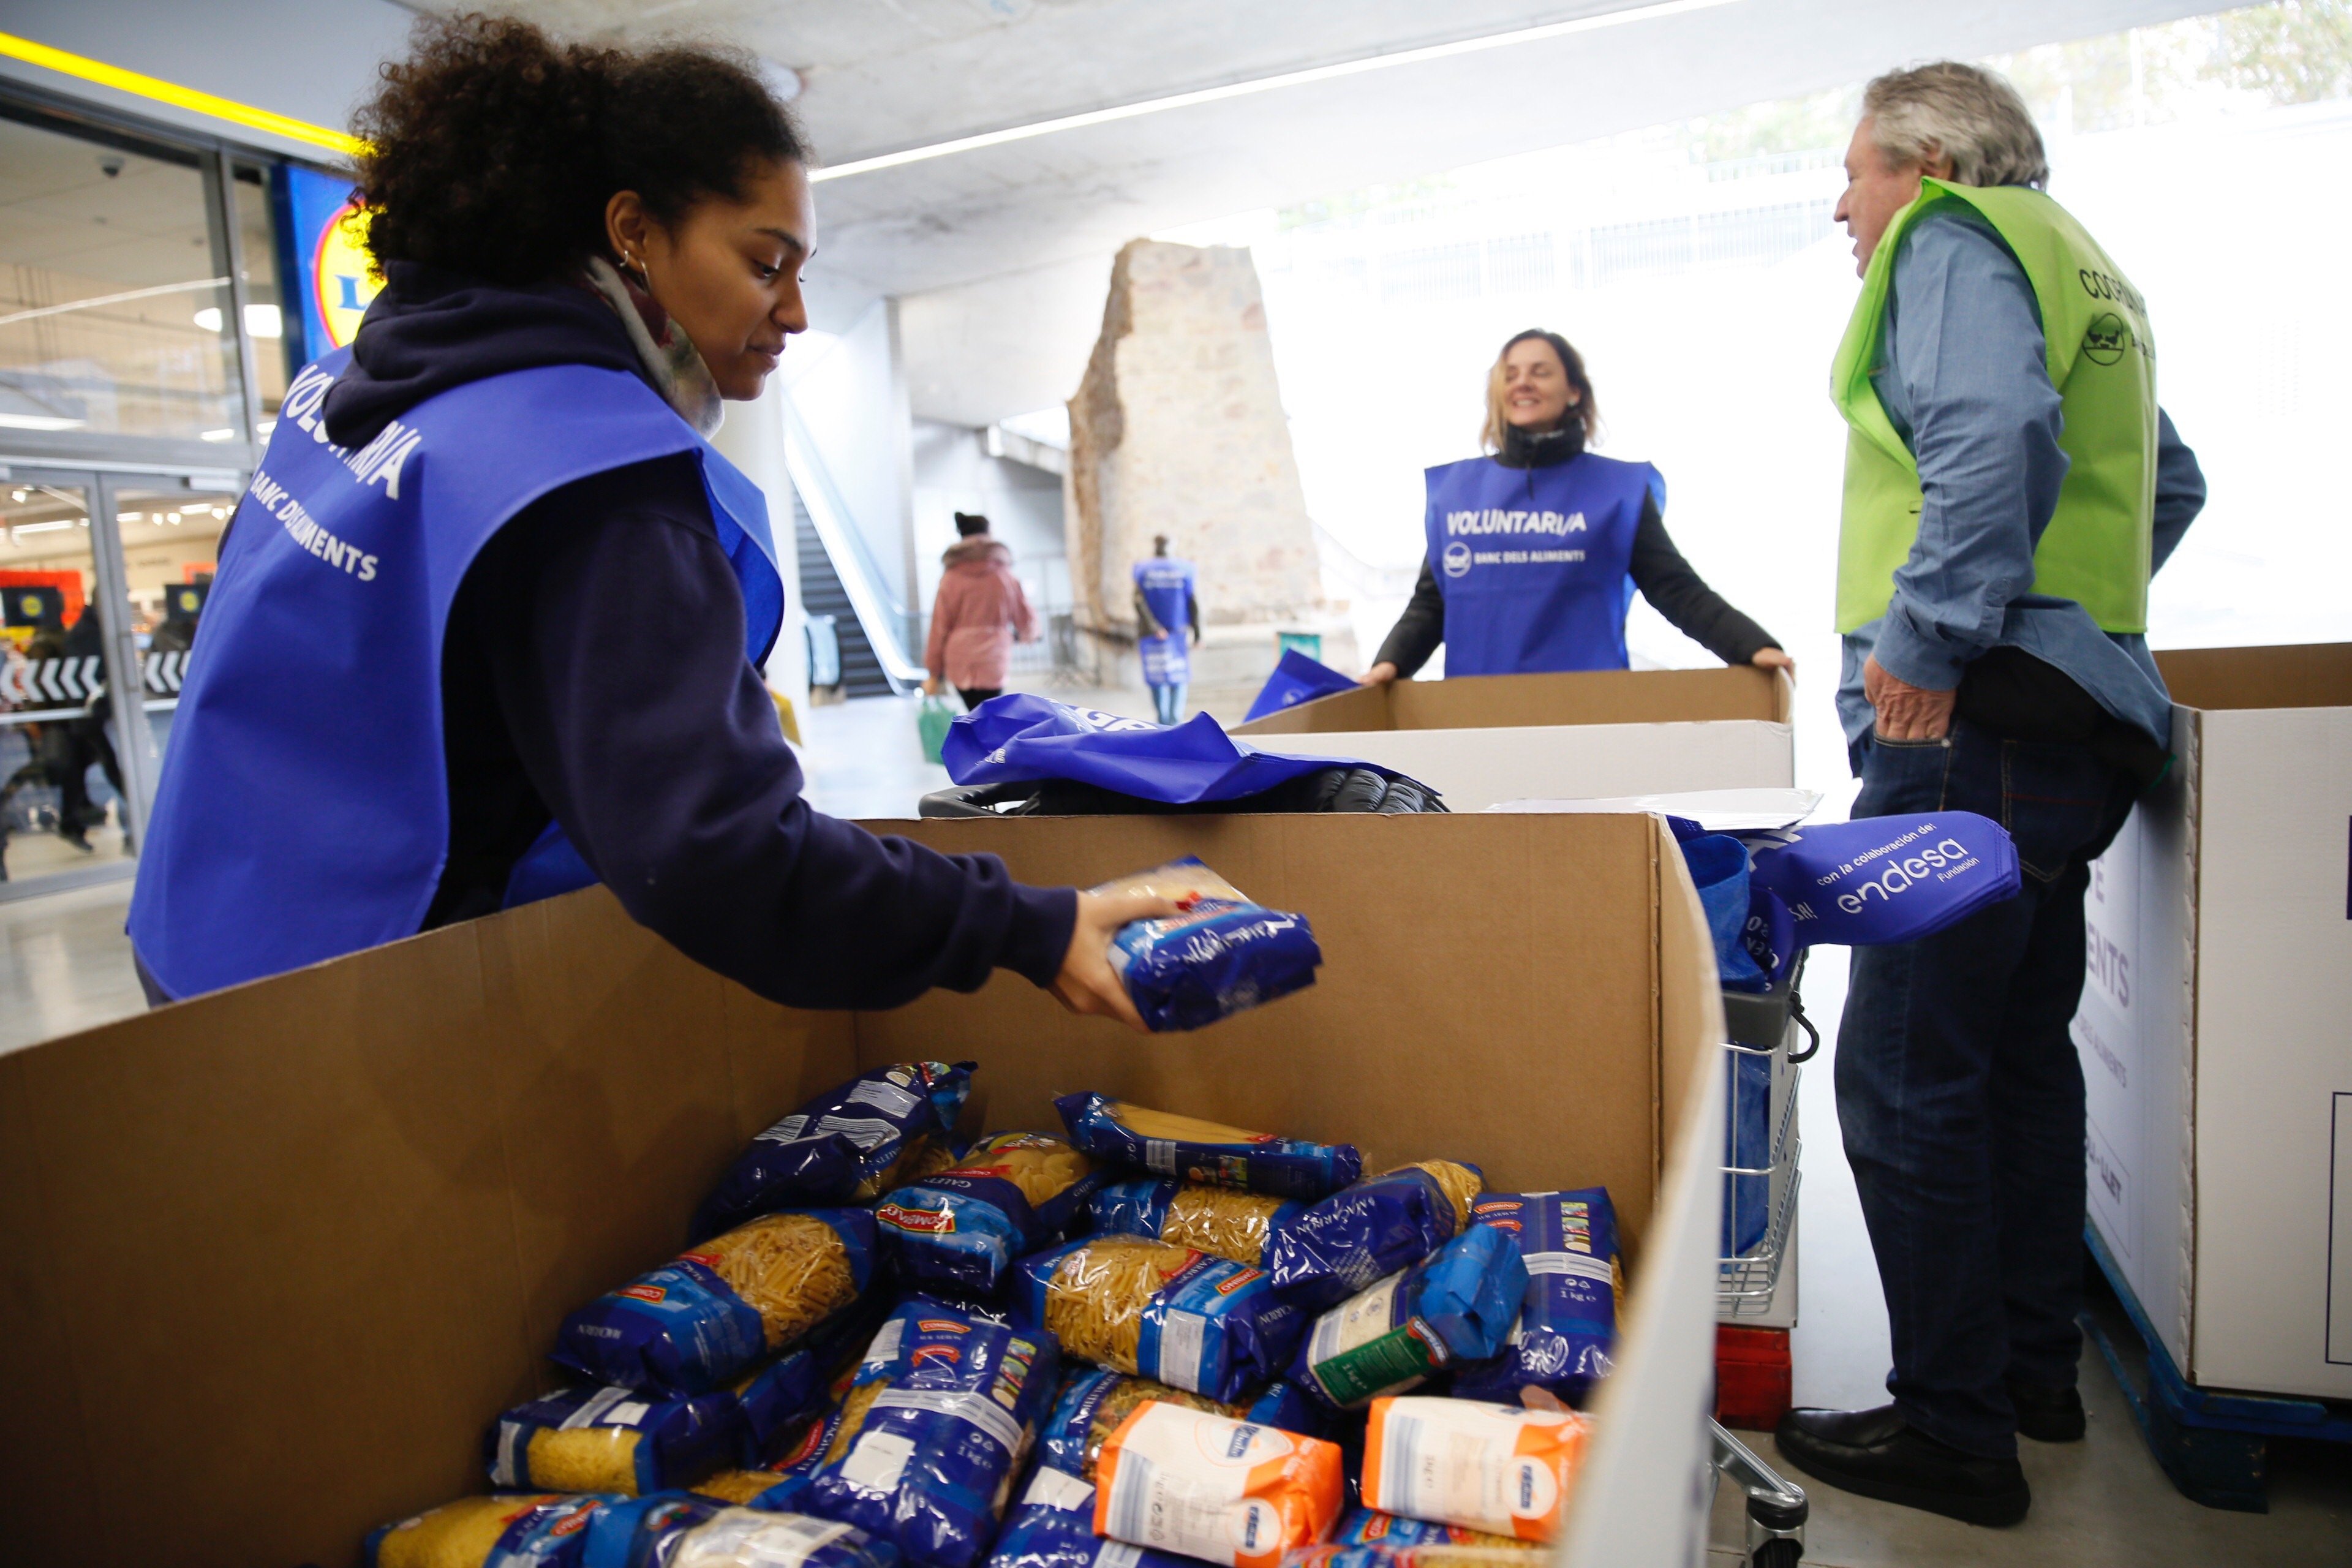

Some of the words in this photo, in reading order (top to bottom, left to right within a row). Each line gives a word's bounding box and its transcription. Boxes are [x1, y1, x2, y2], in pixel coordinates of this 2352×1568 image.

[1817, 870, 1841, 886] con
[1838, 863, 1855, 875] la
[1852, 832, 1920, 867] colaboración
[1838, 837, 1969, 914] endesa
[1936, 858, 1980, 883] Fundación
